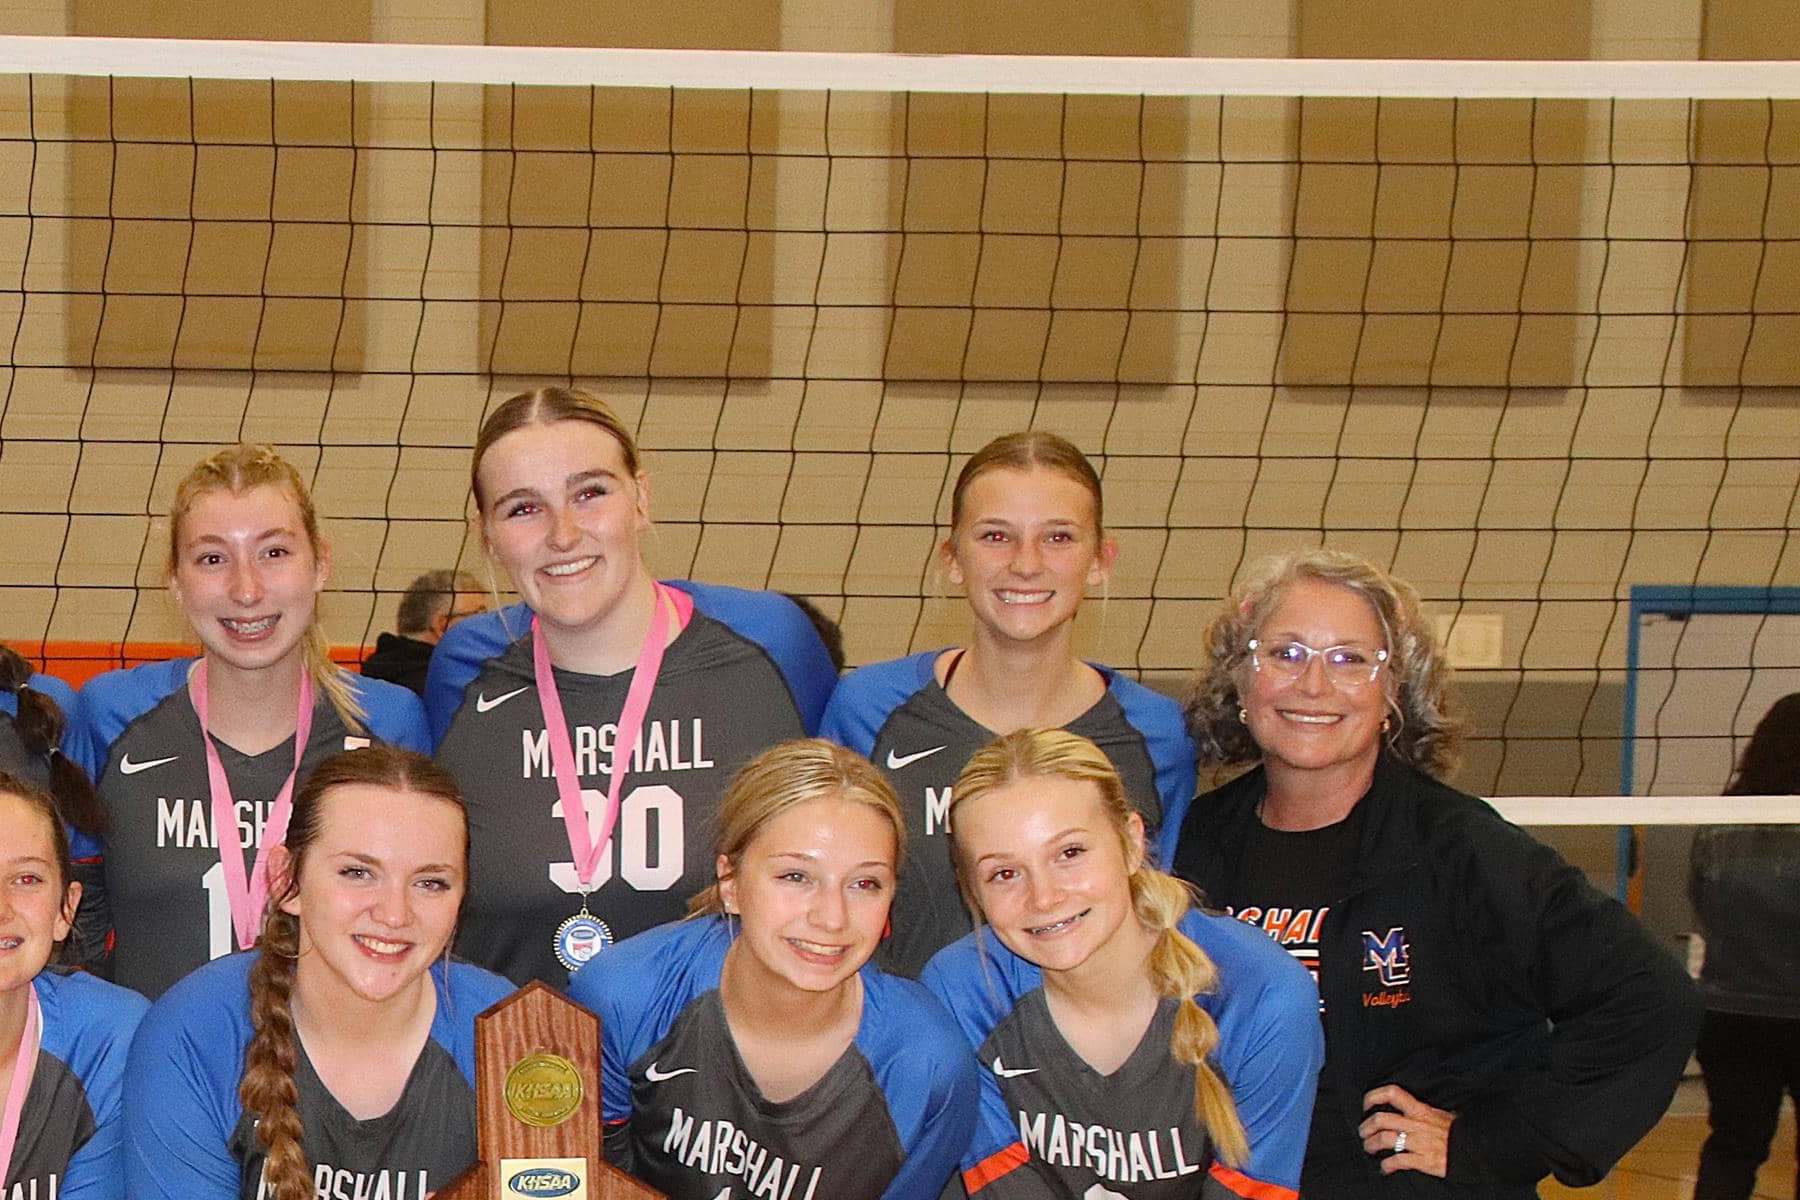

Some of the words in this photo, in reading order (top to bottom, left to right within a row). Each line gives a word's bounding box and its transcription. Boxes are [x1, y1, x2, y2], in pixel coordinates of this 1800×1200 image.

[549, 785, 684, 893] 30
[516, 1173, 572, 1191] KHSAA
[1019, 1110, 1200, 1182] MARSHALL
